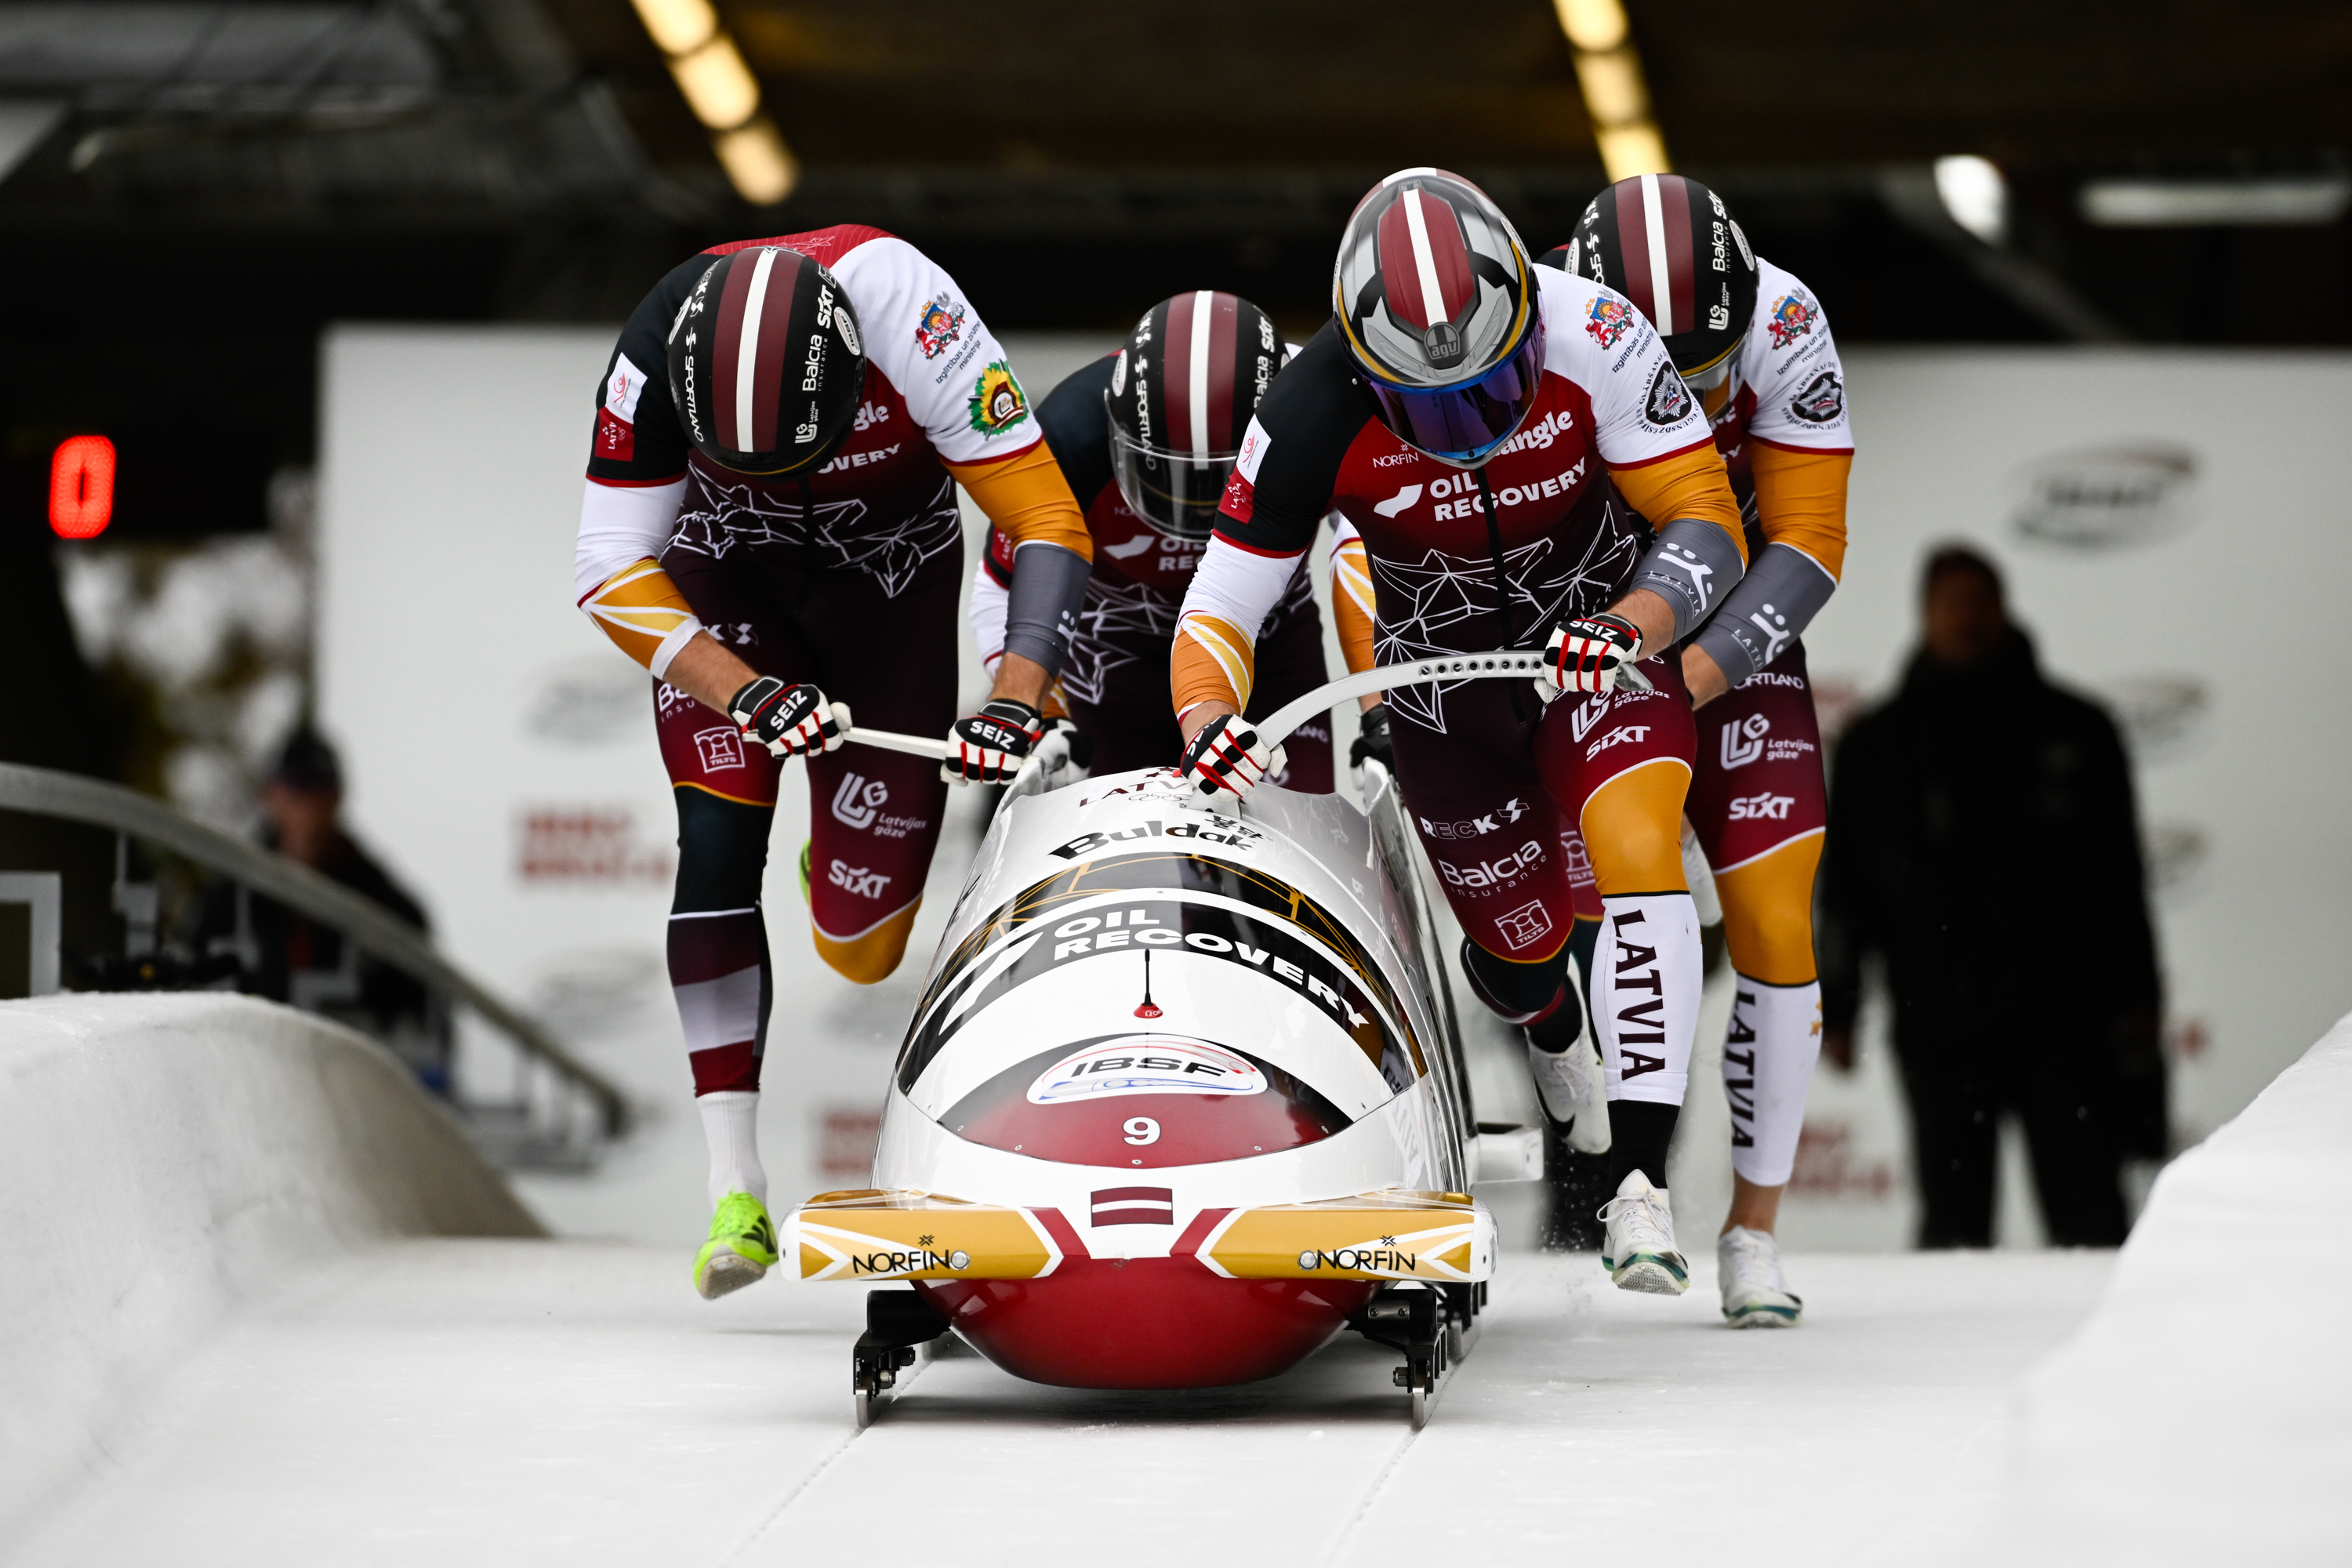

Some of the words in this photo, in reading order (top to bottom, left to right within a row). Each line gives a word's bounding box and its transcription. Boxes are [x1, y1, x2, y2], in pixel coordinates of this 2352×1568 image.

[1711, 221, 1726, 272] Balcia
[817, 285, 833, 328] SIXT
[1637, 328, 1644, 338] un
[1809, 336, 1818, 347] un
[802, 334, 822, 391] Balcia
[818, 337, 828, 391] insurance
[935, 350, 963, 384] Izglītības
[961, 339, 970, 351] un
[958, 339, 982, 370] ministrija
[1432, 341, 1457, 358] agv
[685, 355, 704, 442] SPORTLAND
[1494, 411, 1573, 457] angle
[1373, 452, 1419, 468] NORFIN
[1429, 471, 1479, 499] OIL
[1434, 456, 1585, 522] RECOVERY
[1570, 620, 1618, 642] SEIZ
[1733, 629, 1764, 672] LATVI
[770, 690, 808, 731] SEIZ
[969, 720, 1016, 750] SEIZ
[1586, 725, 1651, 763] SIXT
[1767, 738, 1816, 753] Latvijas
[1766, 749, 1800, 762] gāze
[878, 812, 927, 831] Latvijas
[1728, 792, 1795, 820] SIXT
[1047, 820, 1254, 861] Buldak
[1419, 813, 1501, 840] RECK
[828, 858, 892, 900] SIXT
[1437, 840, 1543, 887] Balcia
[1450, 855, 1547, 898] insurance
[1054, 909, 1160, 938] OIL
[1516, 925, 1545, 945] TILTS
[1054, 928, 1370, 1029] RECOVERY
[1611, 909, 1666, 1082] LATVIA
[1071, 1057, 1227, 1077] IBSF
[1726, 991, 1756, 1149] LATVIA
[1122, 1116, 1162, 1146] 9
[853, 1249, 950, 1274] NORFIN
[1316, 1249, 1416, 1272] NORFIN
